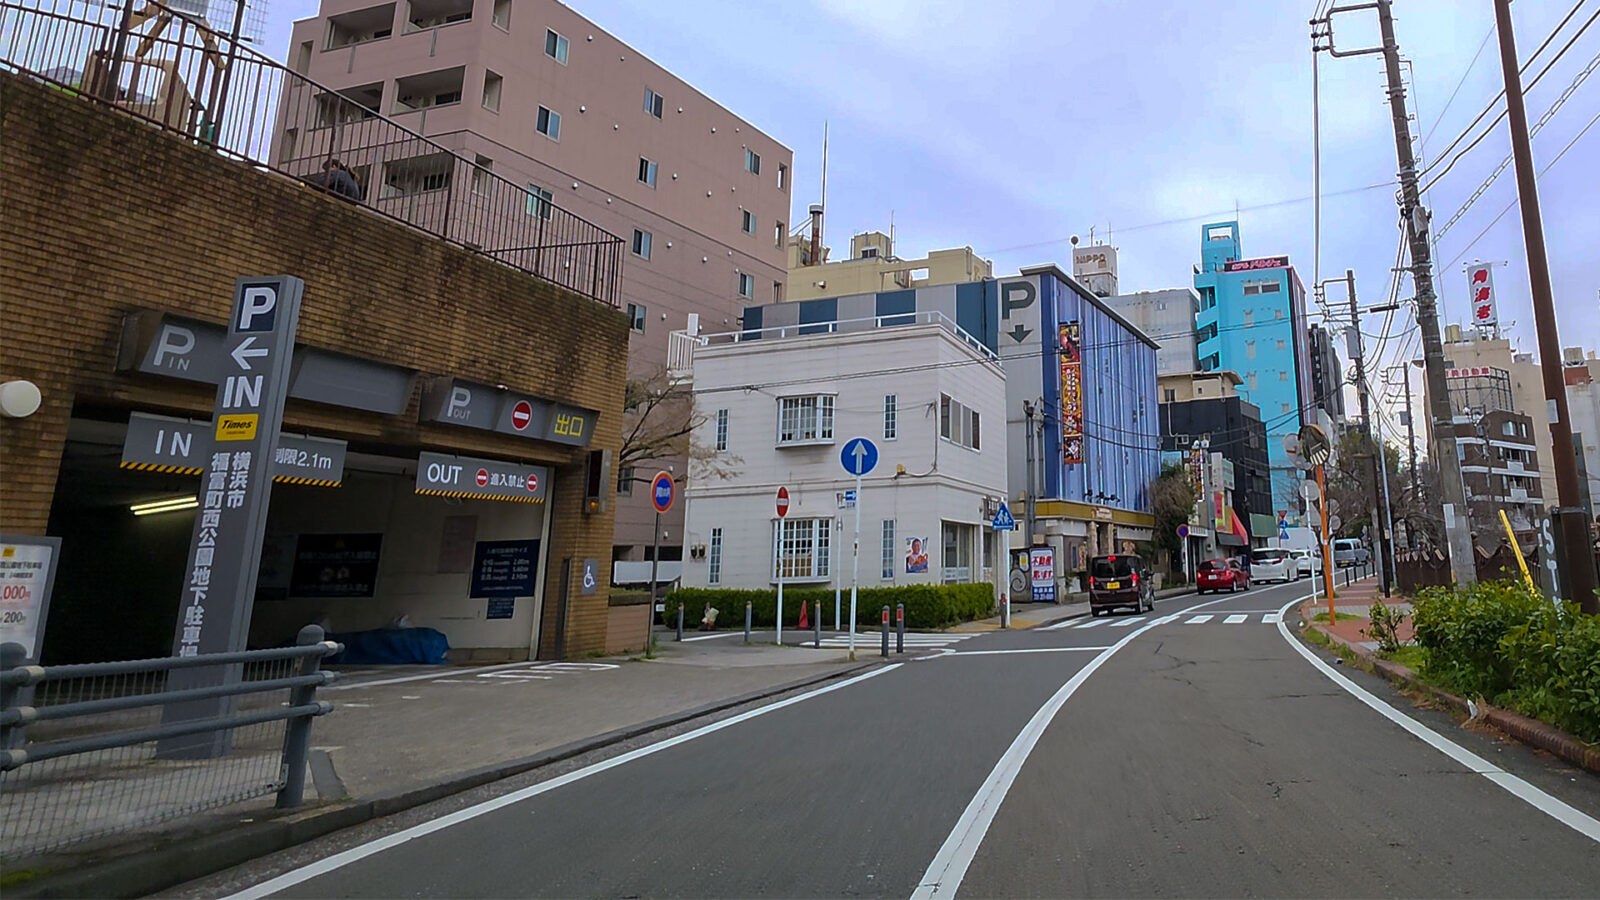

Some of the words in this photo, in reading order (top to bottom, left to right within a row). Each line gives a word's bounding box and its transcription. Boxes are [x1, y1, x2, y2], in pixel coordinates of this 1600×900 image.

[239, 287, 276, 329] P
[1002, 281, 1036, 320] P
[153, 325, 196, 367] P
[169, 356, 191, 371] IN
[222, 375, 263, 408] IN
[447, 386, 471, 417] P
[222, 420, 253, 429] Times
[453, 407, 471, 420] OUT
[554, 413, 584, 437] 出口
[155, 429, 192, 457] IN
[227, 451, 252, 508] 横浜市
[427, 463, 463, 485] OUT
[490, 472, 525, 488] 進入禁止
